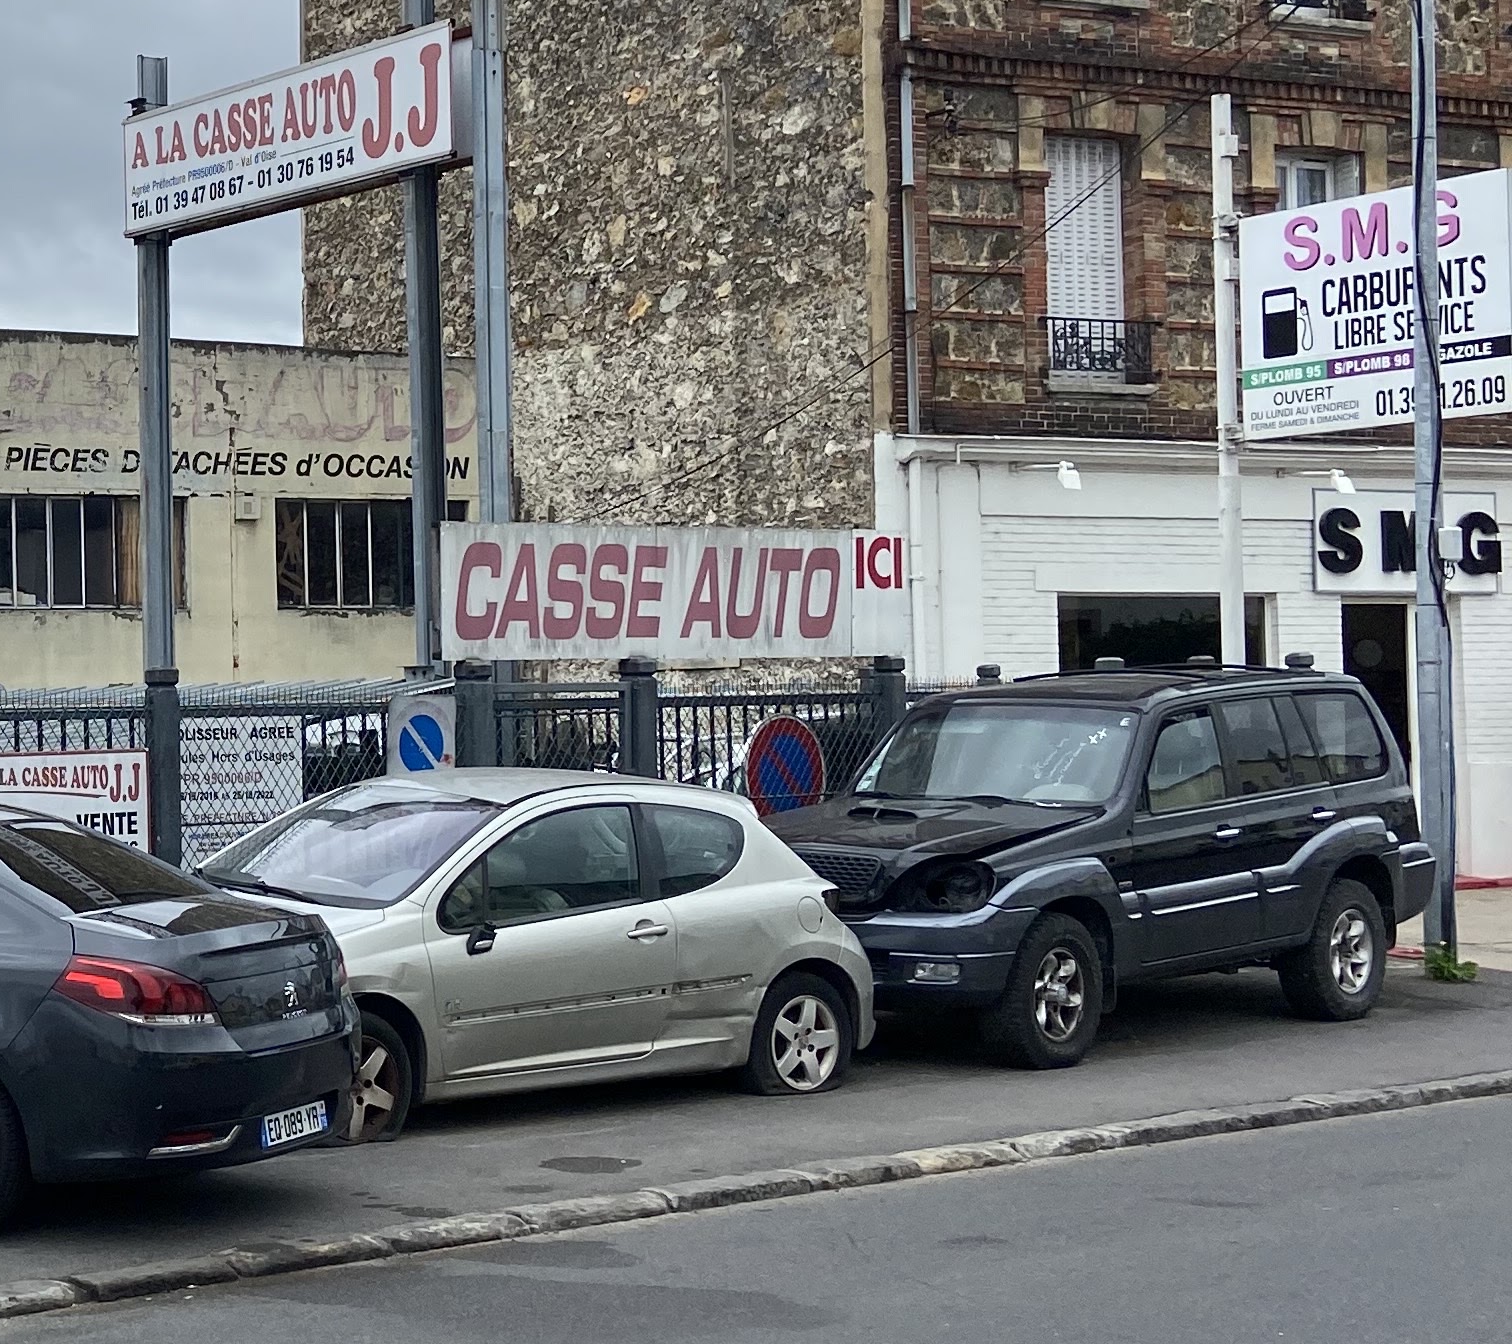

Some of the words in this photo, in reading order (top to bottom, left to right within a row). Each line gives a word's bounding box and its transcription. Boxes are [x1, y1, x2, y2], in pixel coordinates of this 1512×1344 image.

[131, 131, 149, 169] A
[155, 120, 187, 164] LA
[193, 92, 275, 158] CASSE
[281, 69, 357, 143] AUTO
[362, 43, 442, 159] J.J
[240, 154, 252, 167] Val
[131, 199, 152, 220] Tél.
[155, 194, 169, 214] 01
[173, 189, 188, 210] 39
[191, 184, 206, 205] 47
[209, 179, 225, 201] 08
[228, 174, 244, 196] 67
[257, 167, 272, 188] 01
[277, 162, 293, 184] 30
[297, 156, 314, 178] 76
[317, 152, 333, 172] 19
[336, 146, 355, 169] 54
[1321, 255, 1486, 317] CARBURNTS
[1334, 313, 1387, 350] LIBRE
[1393, 300, 1475, 341] SEICE
[1250, 367, 1303, 386] S/PLOMB
[1306, 364, 1322, 378] 95
[1334, 356, 1391, 375] S/PLOMB
[1394, 353, 1411, 367] 98
[1438, 341, 1493, 362] GAZOLE
[1250, 411, 1264, 421] DU
[1265, 407, 1294, 419] LUNDI
[1296, 406, 1309, 416] AU
[1310, 400, 1360, 414] VENDREDI
[1273, 385, 1335, 406] OUVERT
[1278, 418, 1308, 429] SAMEDI
[1316, 411, 1360, 424] DIMANCHE
[4, 442, 109, 473] PIÈCES
[121, 447, 288, 476] DACHÉES
[296, 453, 470, 479] d'OCCAN
[854, 536, 904, 589] ICI
[455, 541, 669, 641] CASSE
[680, 546, 841, 639] AUTO
[22, 766, 67, 789] CASSE
[71, 764, 109, 789] AUTO
[109, 762, 141, 802] J.J
[76, 811, 138, 836] VENTE
